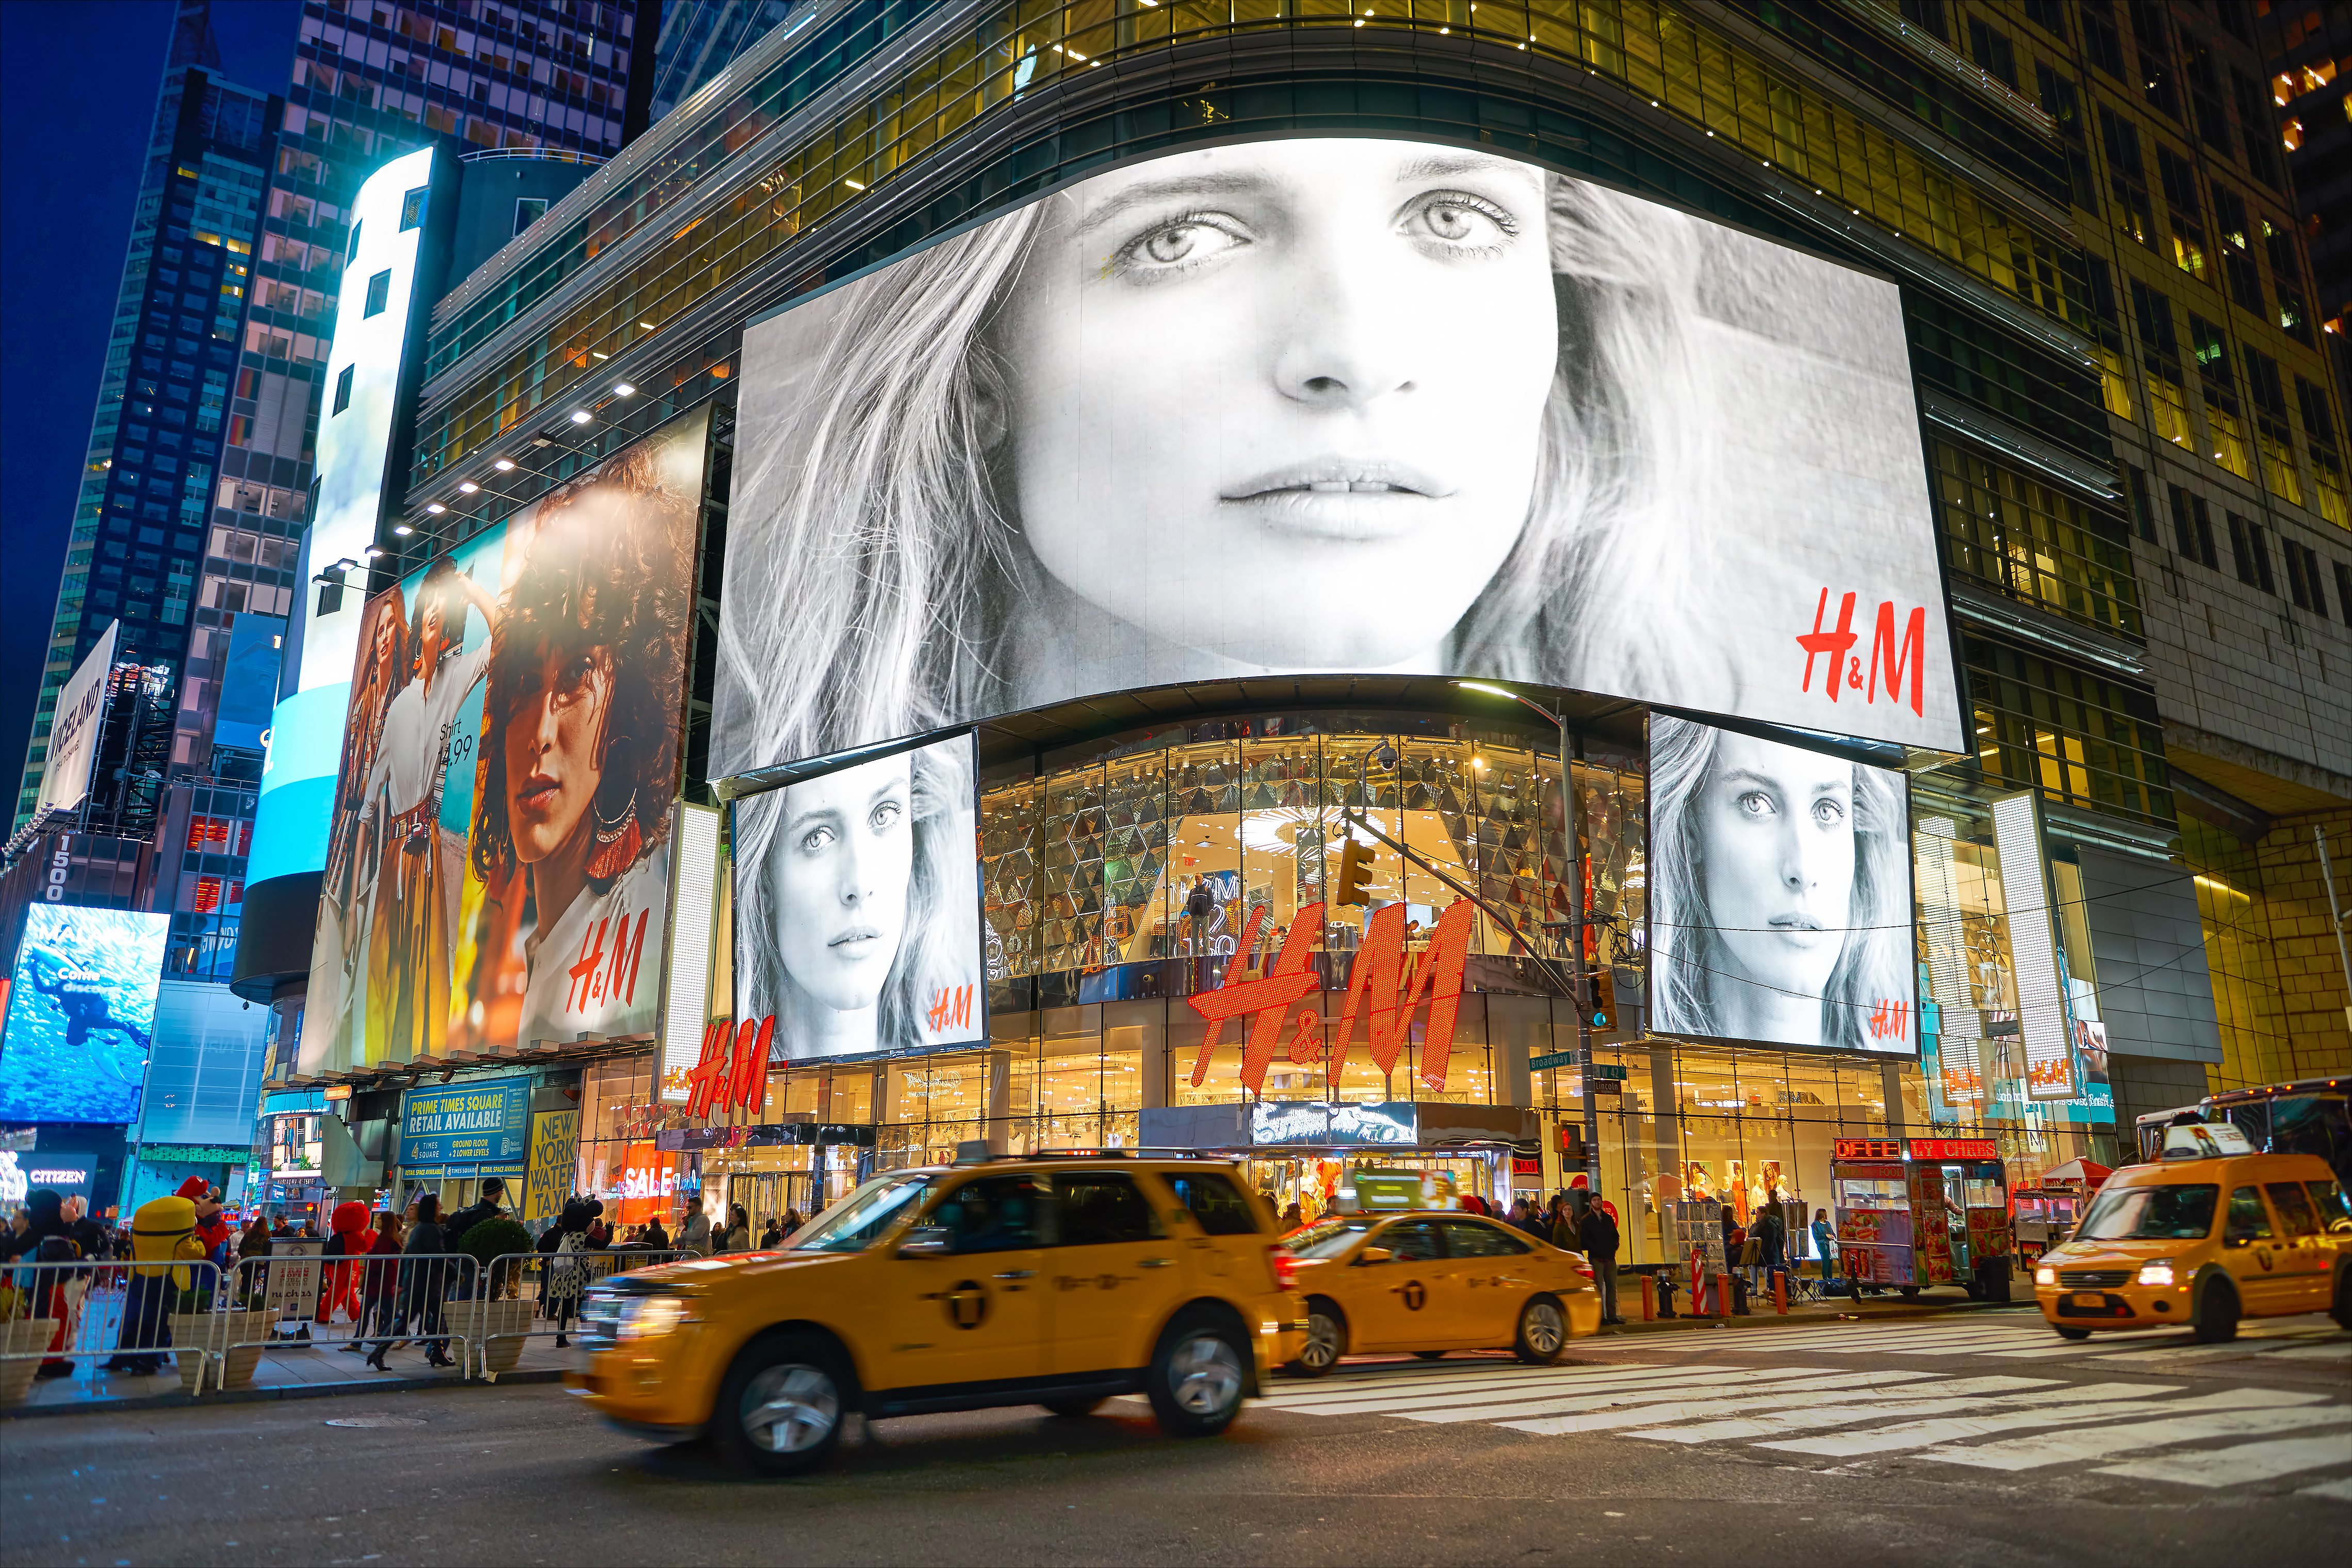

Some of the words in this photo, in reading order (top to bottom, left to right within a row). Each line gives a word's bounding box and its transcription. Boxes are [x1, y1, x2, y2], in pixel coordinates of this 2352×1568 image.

[1796, 587, 1925, 718] H&M
[50, 678, 100, 762] VICELAND
[439, 718, 462, 741] Shirt
[438, 734, 472, 771] 14.99
[46, 835, 70, 901] 1500
[566, 908, 649, 1015] H&M
[58, 968, 101, 981] Come
[929, 984, 973, 1033] H&M
[1187, 900, 1474, 1095] H&M
[1870, 999, 1907, 1042] H&M
[685, 1015, 775, 1119] H&M
[1531, 1054, 1567, 1069] Broadway
[1601, 1066, 1608, 1077] W
[1610, 1067, 1619, 1079] 42
[2030, 1058, 2068, 1087] H&M
[1596, 1082, 1619, 1090] Lincoln
[411, 1100, 438, 1116] PRIME
[440, 1097, 464, 1113] TIMES
[467, 1093, 503, 1111] SQUARE
[410, 1115, 442, 1133] RETAIL
[445, 1110, 502, 1131] AVAILABLE
[542, 1112, 575, 1142] NEW
[412, 1141, 419, 1159] 4
[452, 1140, 472, 1148] GROUND
[472, 1139, 488, 1147] FLOOR
[473, 1148, 489, 1156] LEVELS
[536, 1136, 575, 1167] YORK
[30, 1169, 87, 1183] CITIZEN
[447, 1166, 451, 1176] 4
[530, 1162, 574, 1192] WATER
[624, 1167, 673, 1197] SALE
[1835, 1167, 1865, 1177] HALAL
[1880, 1167, 1903, 1178] FOOD
[2045, 1178, 2062, 1187] NUTS
[2065, 1178, 2083, 1187] NUTS
[2022, 1243, 2043, 1255] NUTS
